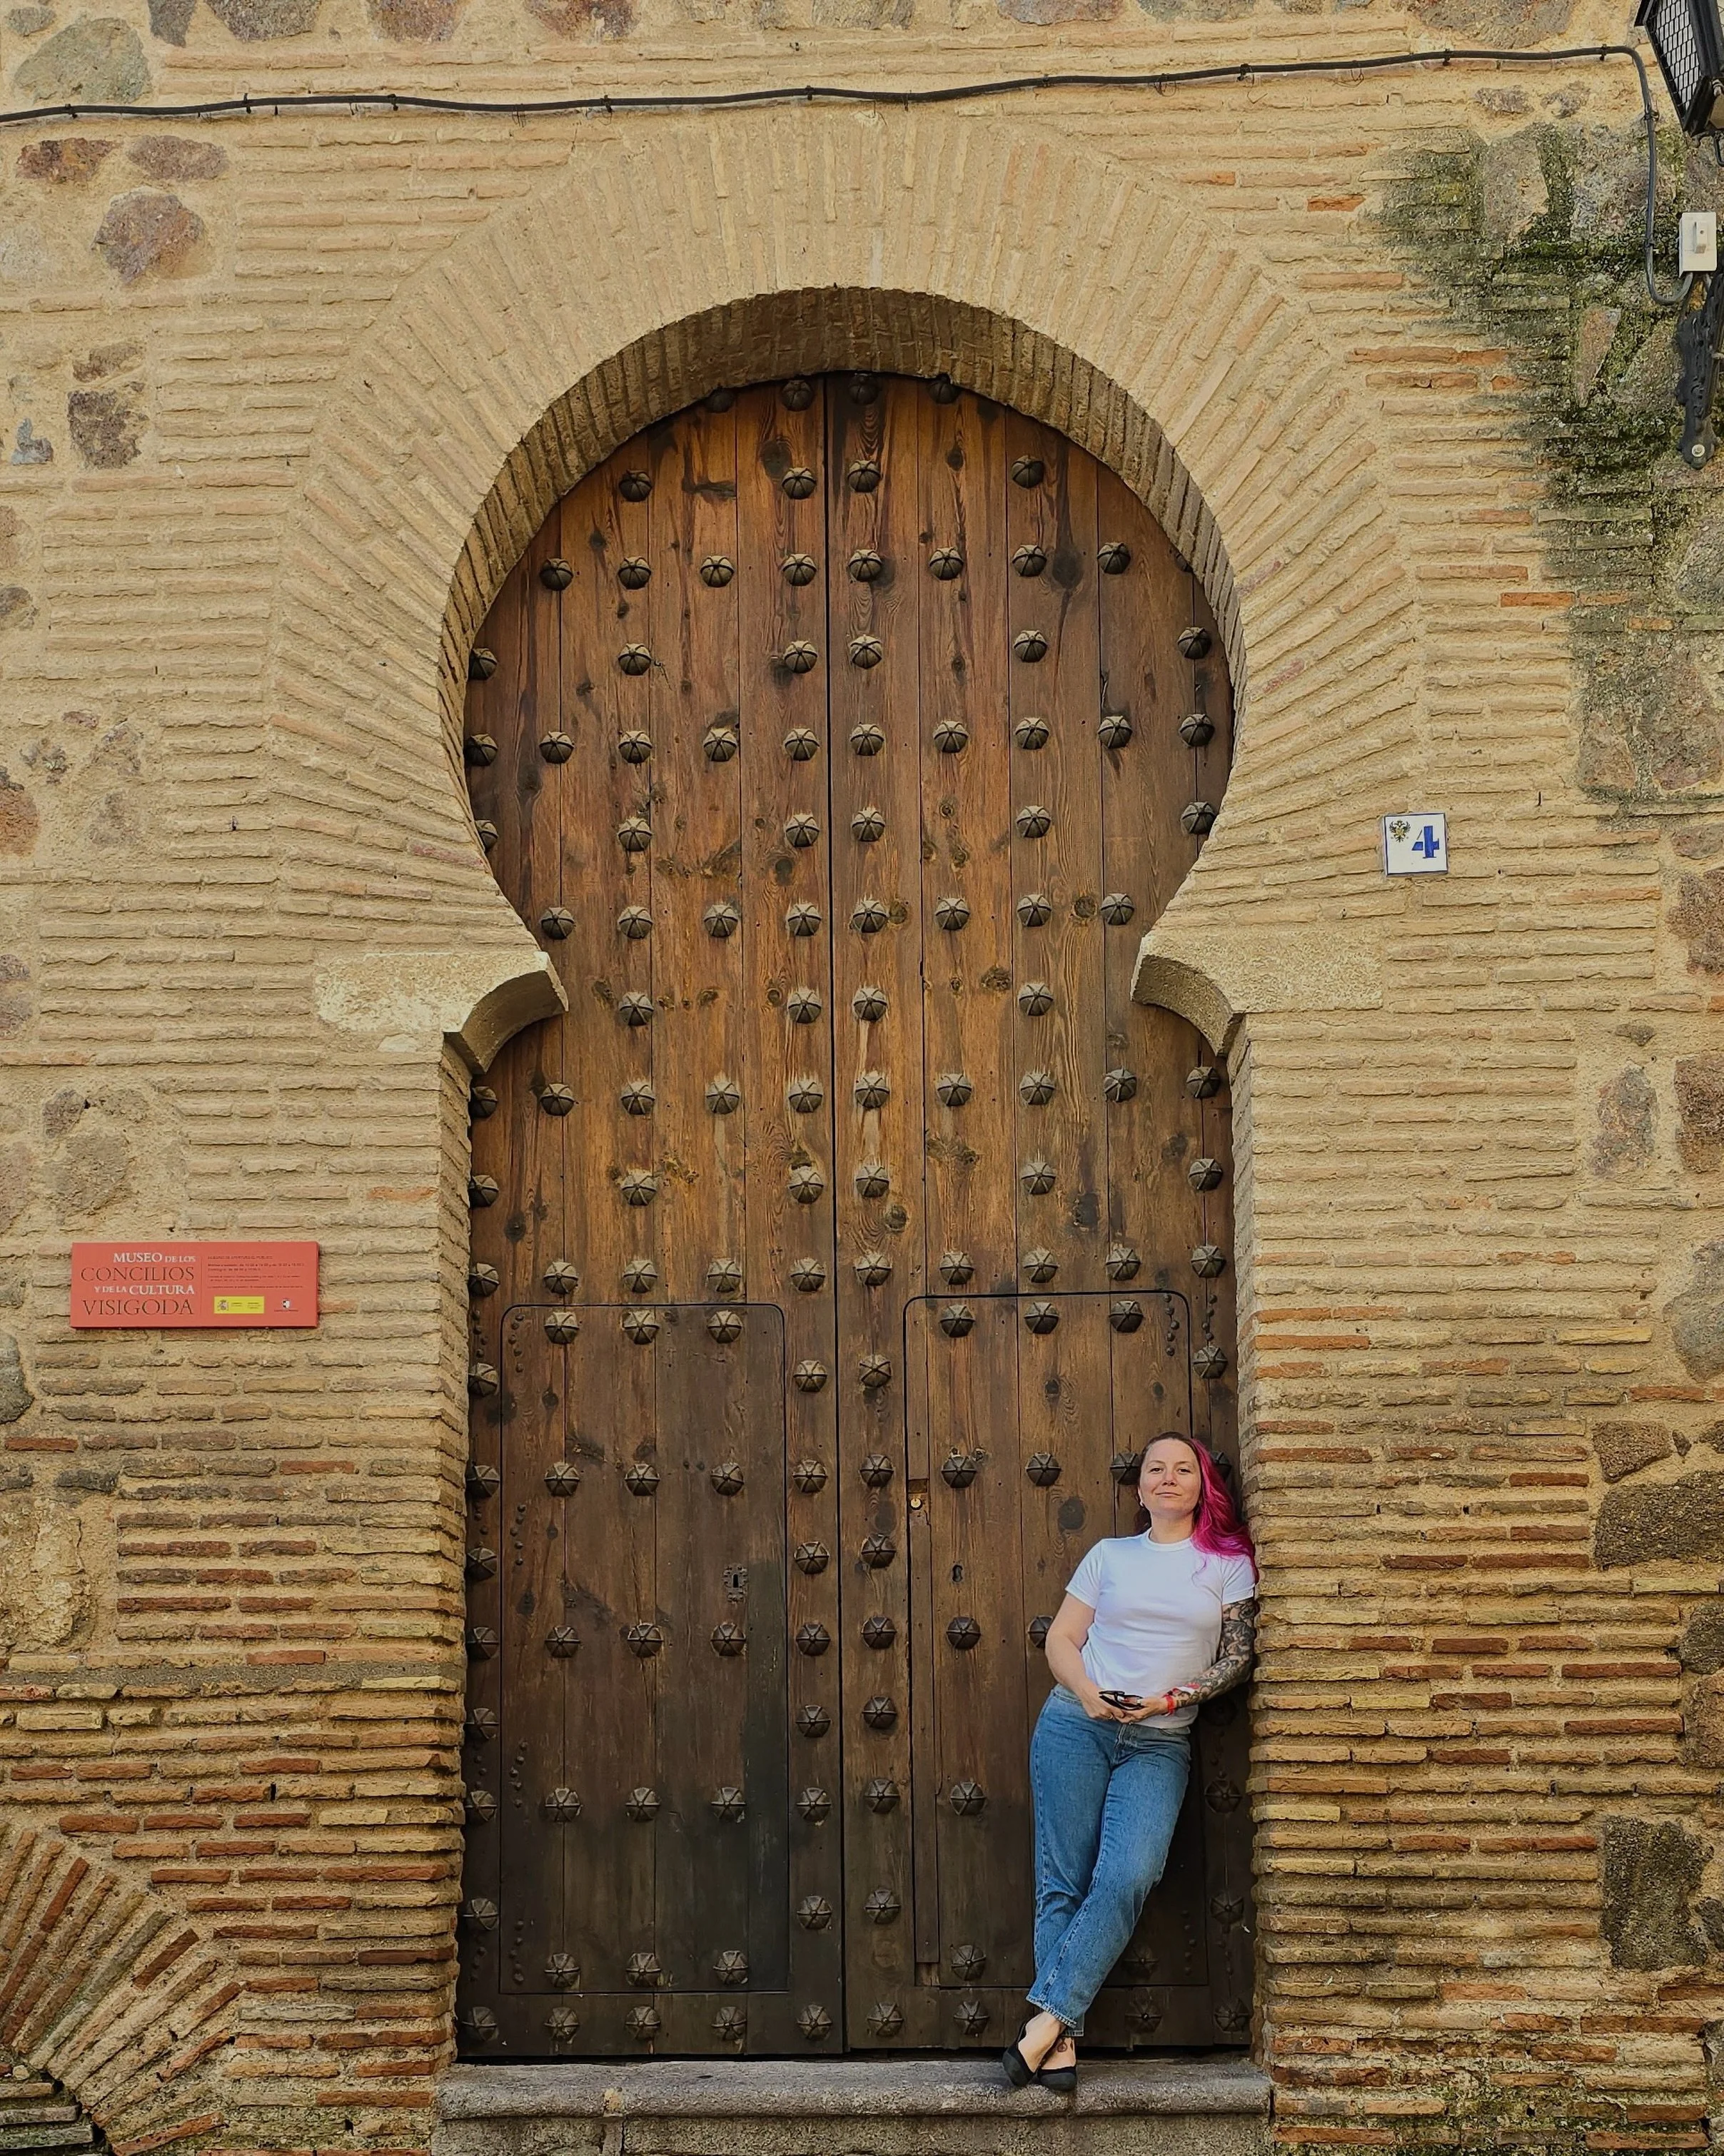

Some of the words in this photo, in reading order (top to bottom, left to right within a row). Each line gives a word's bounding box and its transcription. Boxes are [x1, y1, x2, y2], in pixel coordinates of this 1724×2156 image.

[1411, 825, 1439, 859] 4
[114, 1252, 163, 1262] MUSEO
[81, 1267, 195, 1282] CONCILIOS
[129, 1285, 195, 1295] CULTURA
[82, 1299, 194, 1315] VISIGODA
